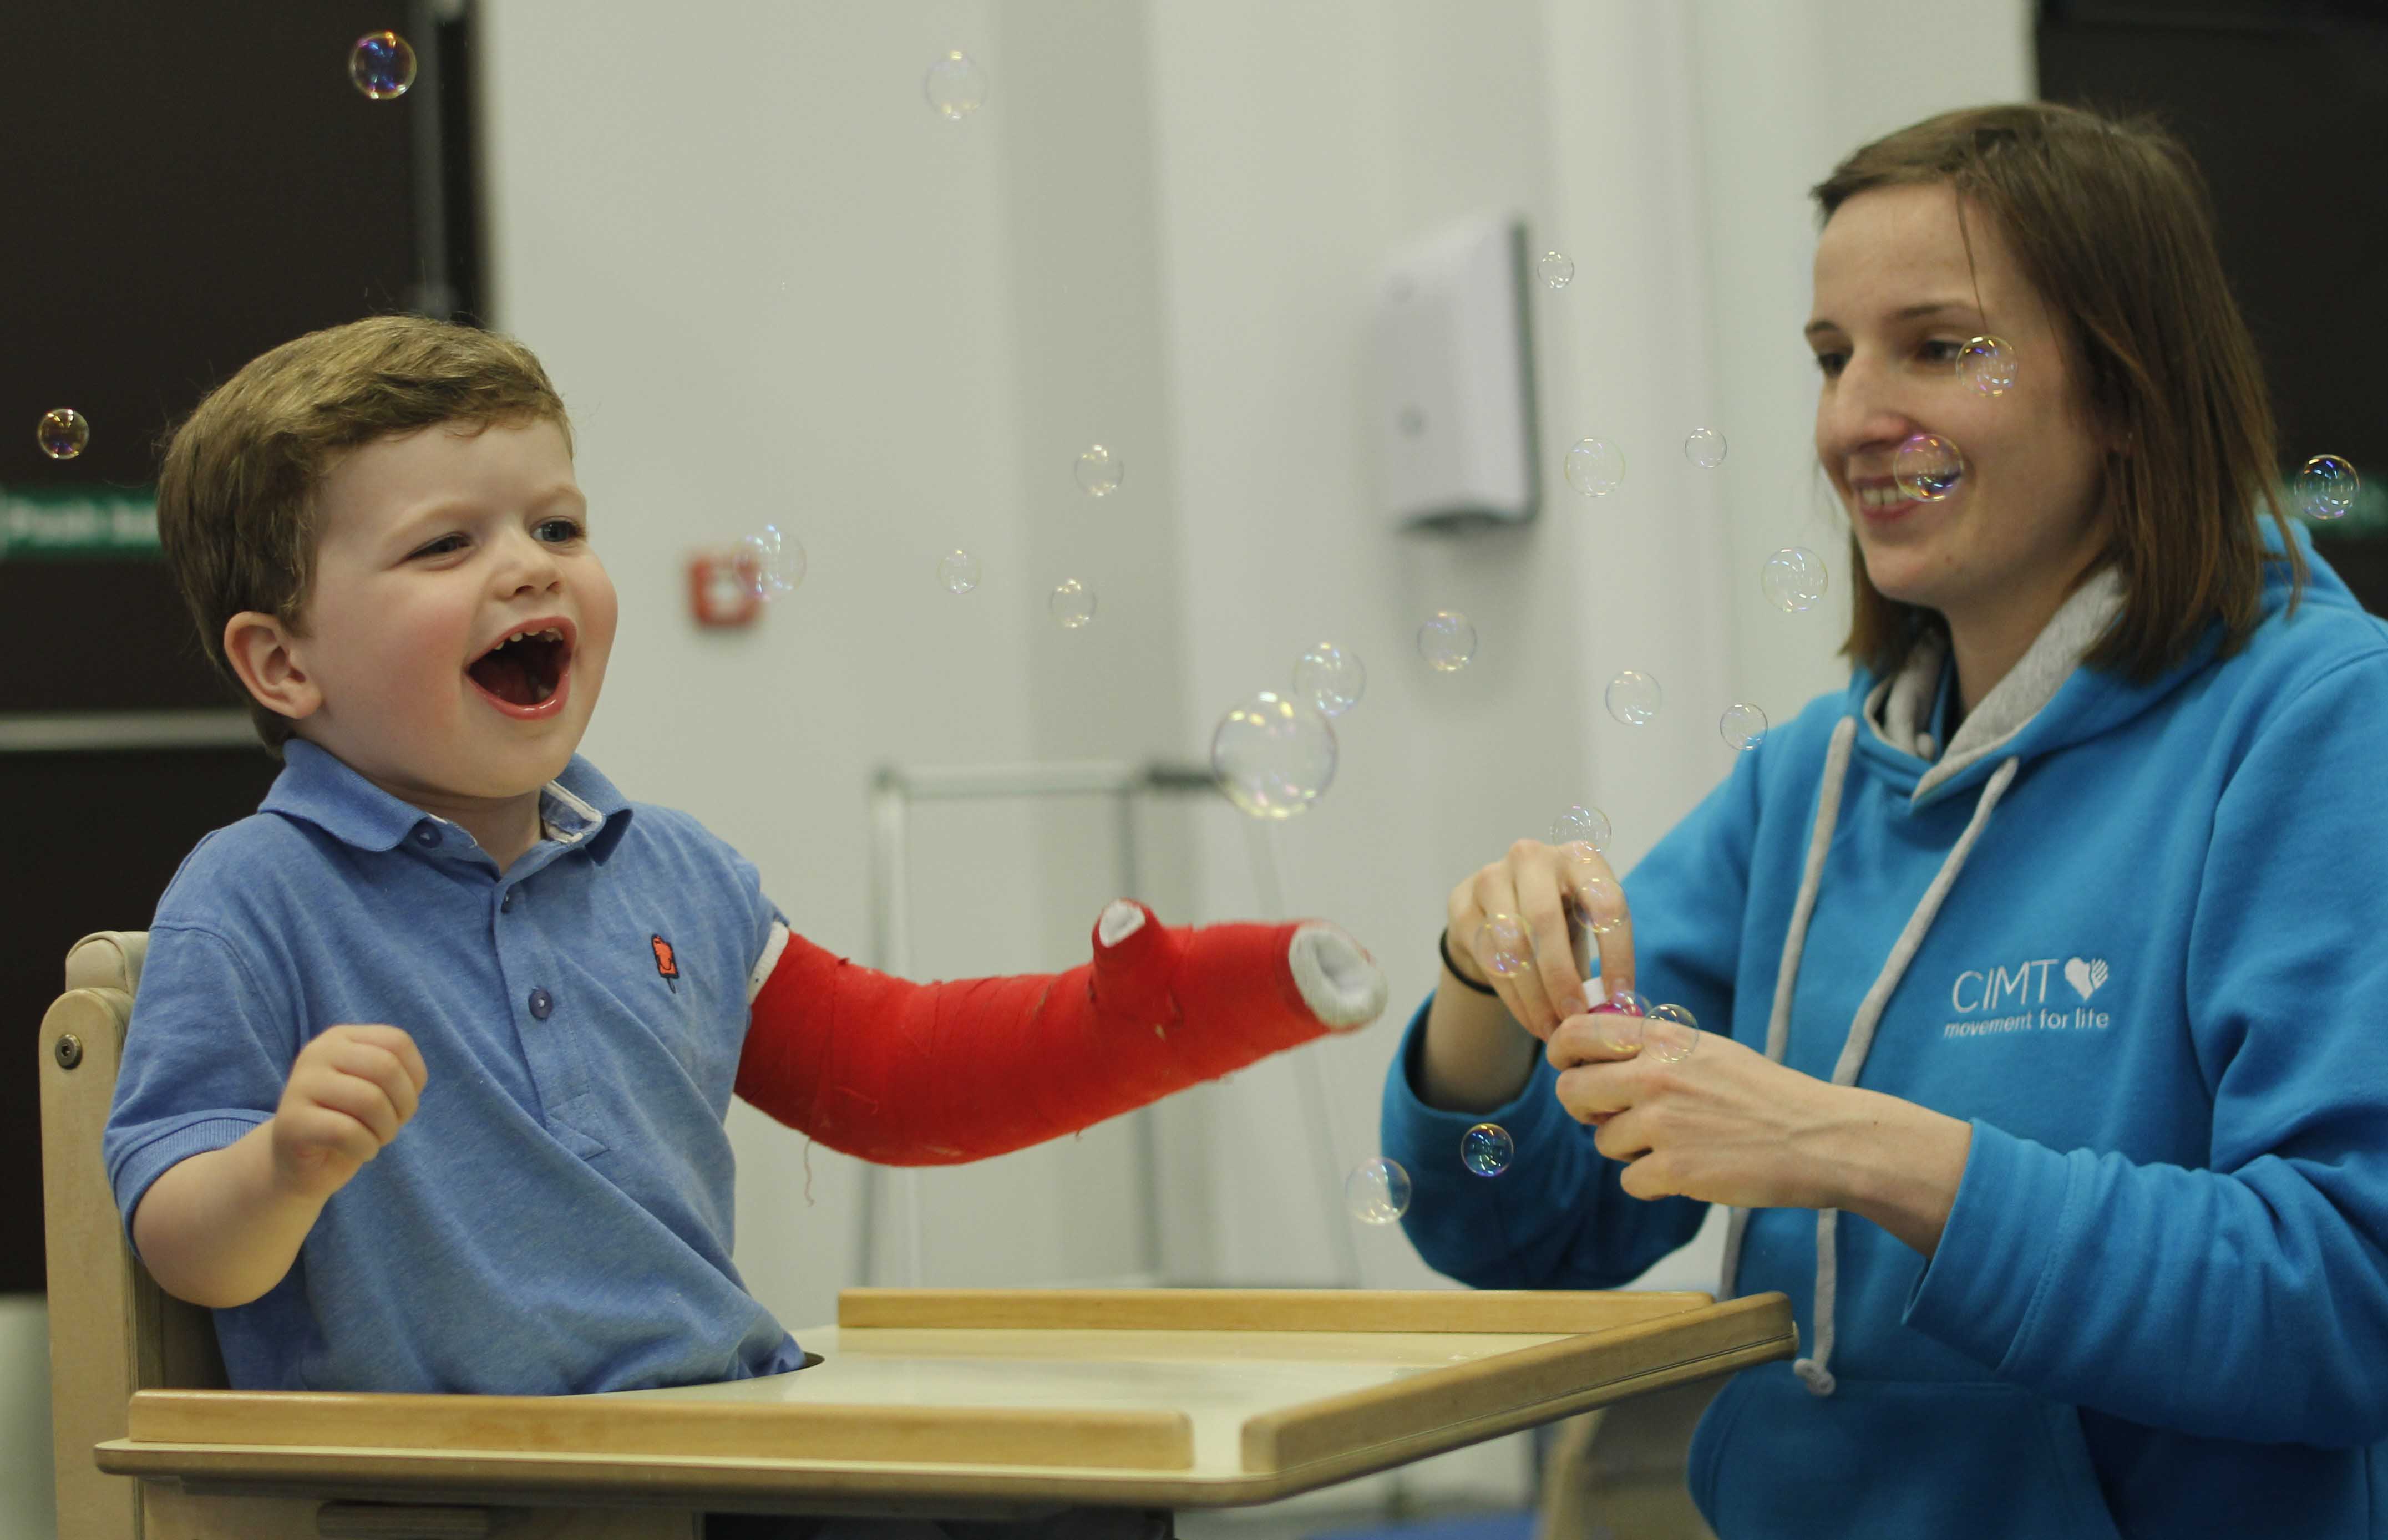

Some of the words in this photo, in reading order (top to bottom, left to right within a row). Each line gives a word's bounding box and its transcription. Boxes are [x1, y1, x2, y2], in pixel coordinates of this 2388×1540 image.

[1953, 959, 2059, 1013] CIMT
[1944, 1012, 2032, 1038] movement
[2039, 1008, 2068, 1029] for
[2075, 1007, 2110, 1029] life
